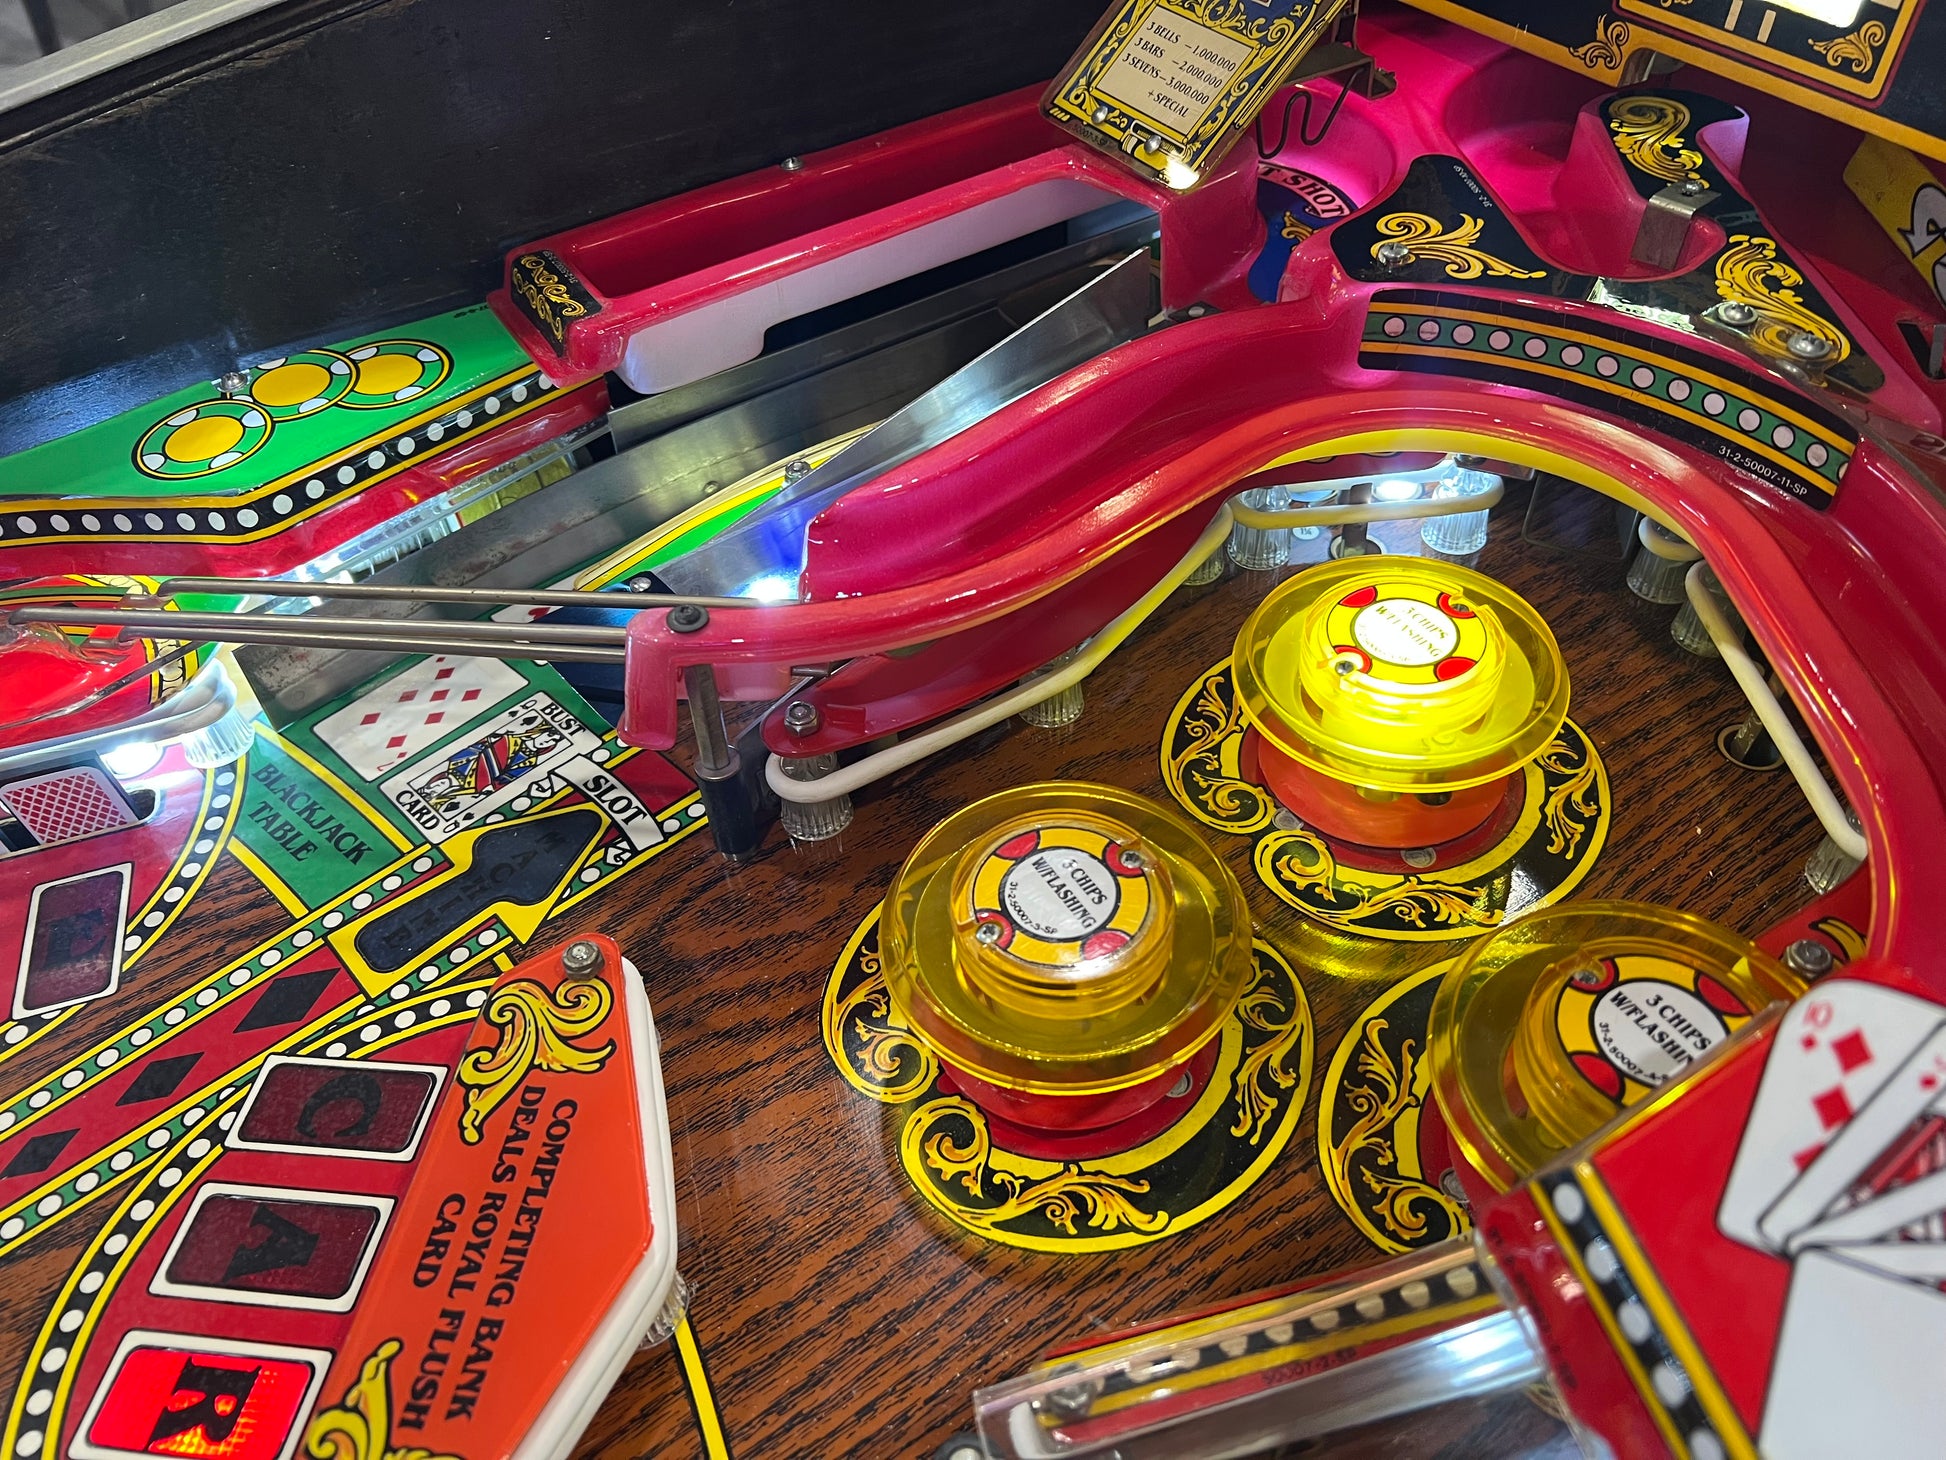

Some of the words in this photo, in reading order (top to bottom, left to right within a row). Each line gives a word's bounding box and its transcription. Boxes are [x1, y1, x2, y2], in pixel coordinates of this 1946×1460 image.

[1134, 37, 1143, 46] 3
[1141, 40, 1166, 58] BARS
[1146, 22, 1156, 31] 3
[1153, 24, 1181, 44] BELLS
[1122, 53, 1131, 62] 3
[1128, 56, 1162, 78] SEVENS
[1282, 174, 1346, 215] SHOT
[1718, 445, 1808, 496] 31-2-50007-11-SP
[520, 700, 538, 710] Q
[540, 702, 586, 737] BUST
[248, 800, 318, 862] TABLE
[251, 762, 374, 866] BLACKJACK
[396, 790, 440, 830] CARD
[442, 820, 460, 834] Q
[582, 774, 648, 826] SLOT
[1031, 856, 1097, 930] W/FLASHING
[1070, 867, 1109, 906] CHIPS
[42, 907, 108, 972] E
[1609, 990, 1694, 1064] W/FLASHIN
[1646, 994, 1664, 1006] 3
[1658, 1006, 1712, 1051] CHIPS
[1802, 998, 1834, 1029] 10
[294, 1071, 384, 1138] C
[491, 1084, 546, 1184] DEALS
[492, 1098, 578, 1308] COMPLETING
[223, 1206, 321, 1282] A
[412, 1192, 466, 1288] CARD
[448, 1191, 508, 1300] ROYAL
[398, 1307, 465, 1430] FLUSH
[444, 1316, 504, 1421] BANK
[146, 1355, 263, 1452] R
